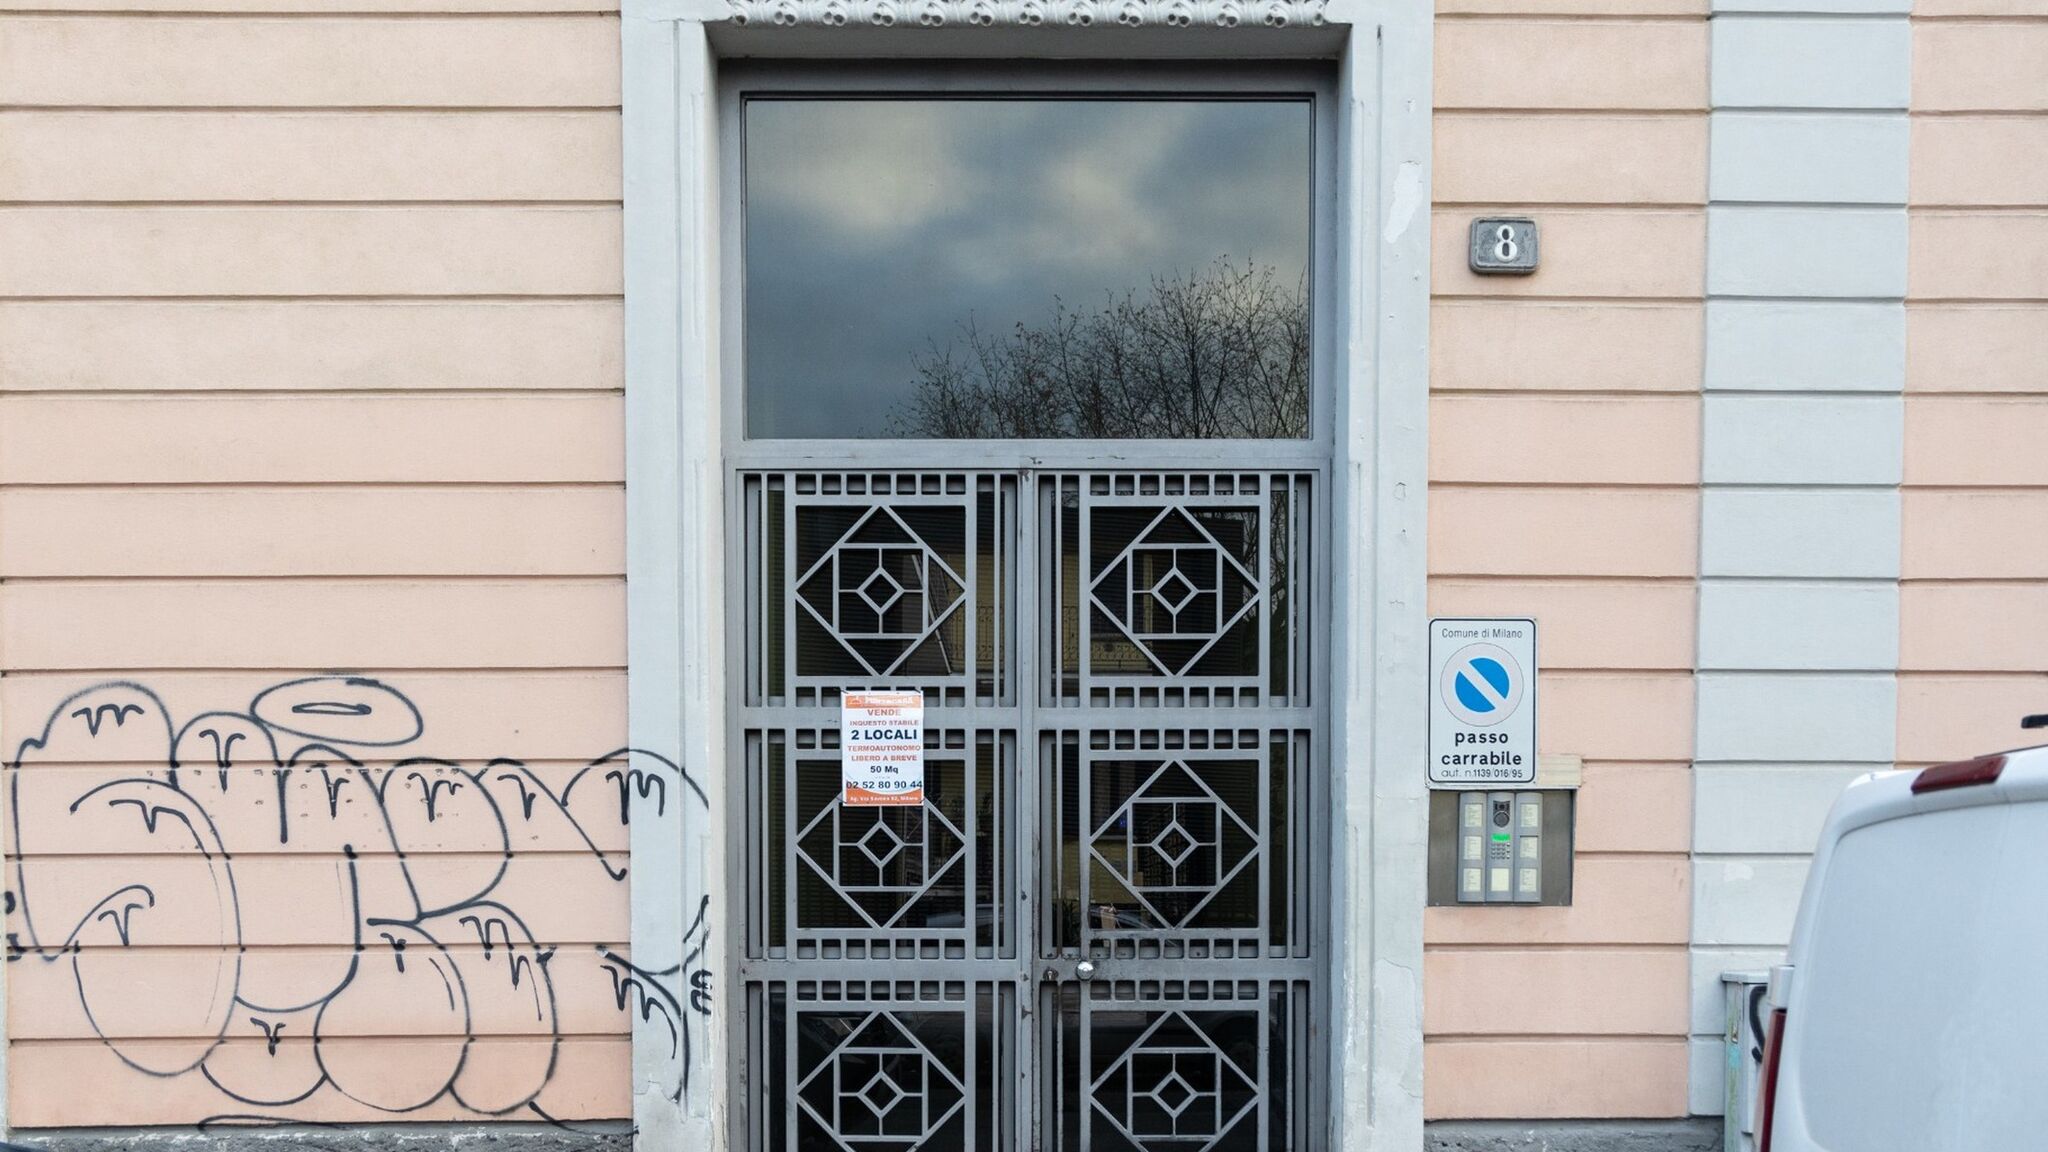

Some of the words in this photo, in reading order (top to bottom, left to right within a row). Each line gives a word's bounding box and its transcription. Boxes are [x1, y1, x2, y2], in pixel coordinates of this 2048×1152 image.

[1494, 224, 1517, 262] 8
[1442, 628, 1478, 638] Comune
[1482, 628, 1490, 638] di
[1492, 629, 1522, 638] Milano
[851, 730, 859, 740] 2
[864, 729, 917, 740] LOCALI
[1455, 732, 1508, 746] passo
[1441, 751, 1522, 766] carrabile
[884, 766, 898, 774] Mq
[1441, 769, 1462, 777] aut.
[847, 781, 858, 789] 02
[862, 781, 875, 789] 52
[878, 781, 890, 789] 80
[894, 781, 906, 789] 90
